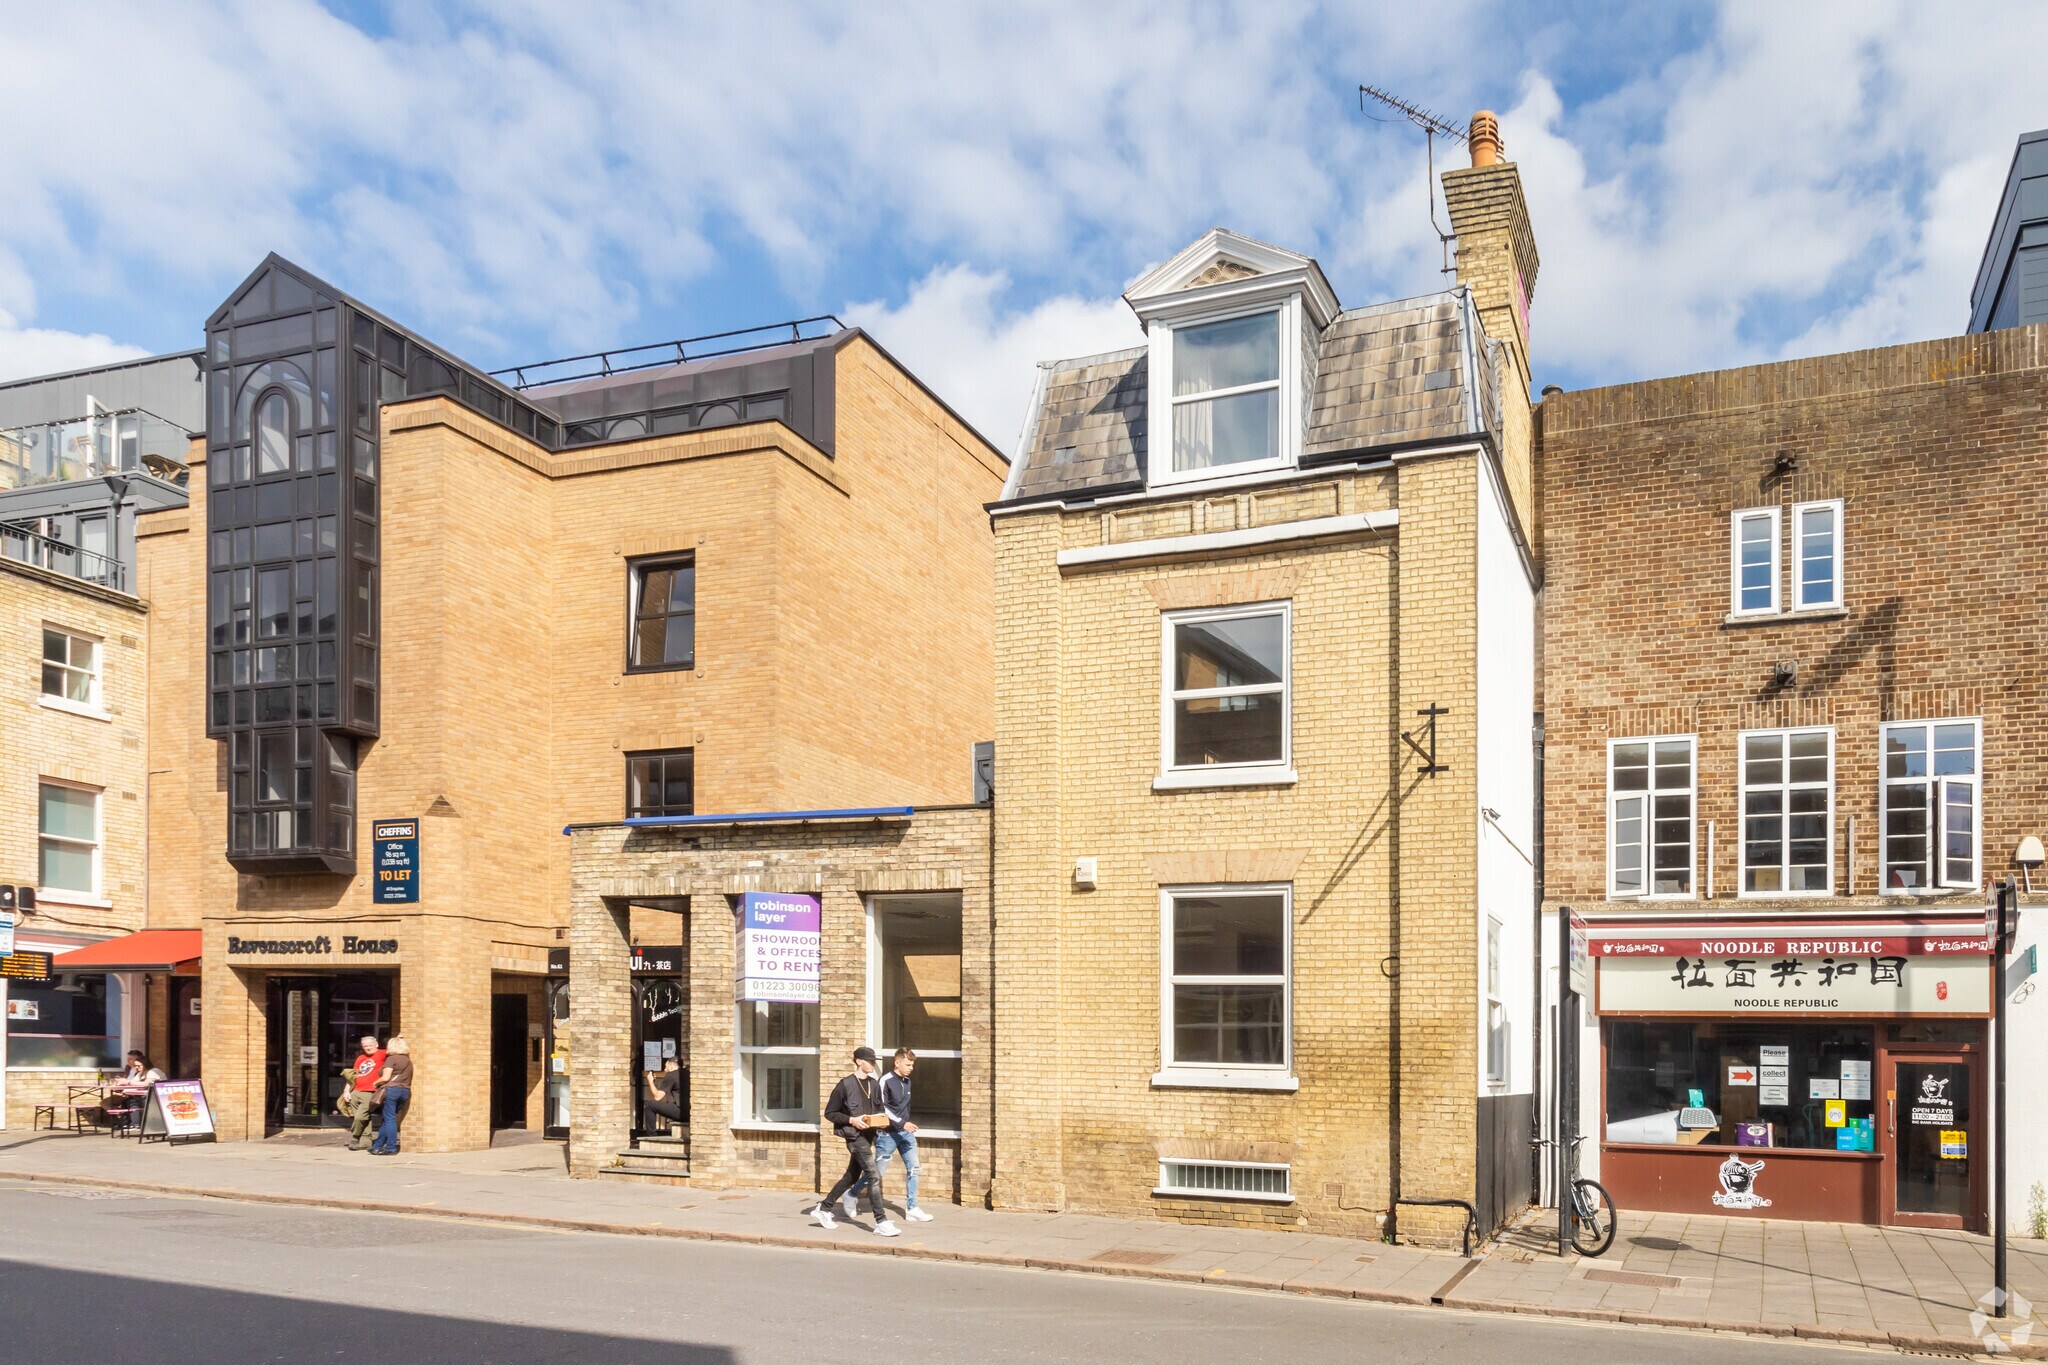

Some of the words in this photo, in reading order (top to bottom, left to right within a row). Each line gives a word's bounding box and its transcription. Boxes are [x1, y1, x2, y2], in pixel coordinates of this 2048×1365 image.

[378, 826, 412, 837] CHEFFINS
[379, 870, 392, 881] TO
[393, 869, 412, 880] LET
[754, 900, 811, 913] robinson
[754, 911, 786, 924] layer
[227, 935, 332, 954] Ravenscroft
[342, 936, 399, 954] House
[752, 934, 821, 946] SHOWROO
[757, 946, 766, 955] &
[770, 947, 822, 958] OFFICES
[1701, 942, 1775, 954] NOODLE
[1786, 941, 1882, 954] REPUBLIC
[757, 960, 777, 971] TO
[783, 961, 821, 972] RENT
[1671, 956, 1908, 989] 拉面共和国
[753, 980, 785, 991] 01223
[1734, 999, 1780, 1007] NOODLE
[1784, 999, 1839, 1007] REPUBLIC
[651, 1011, 668, 1022] Bubble
